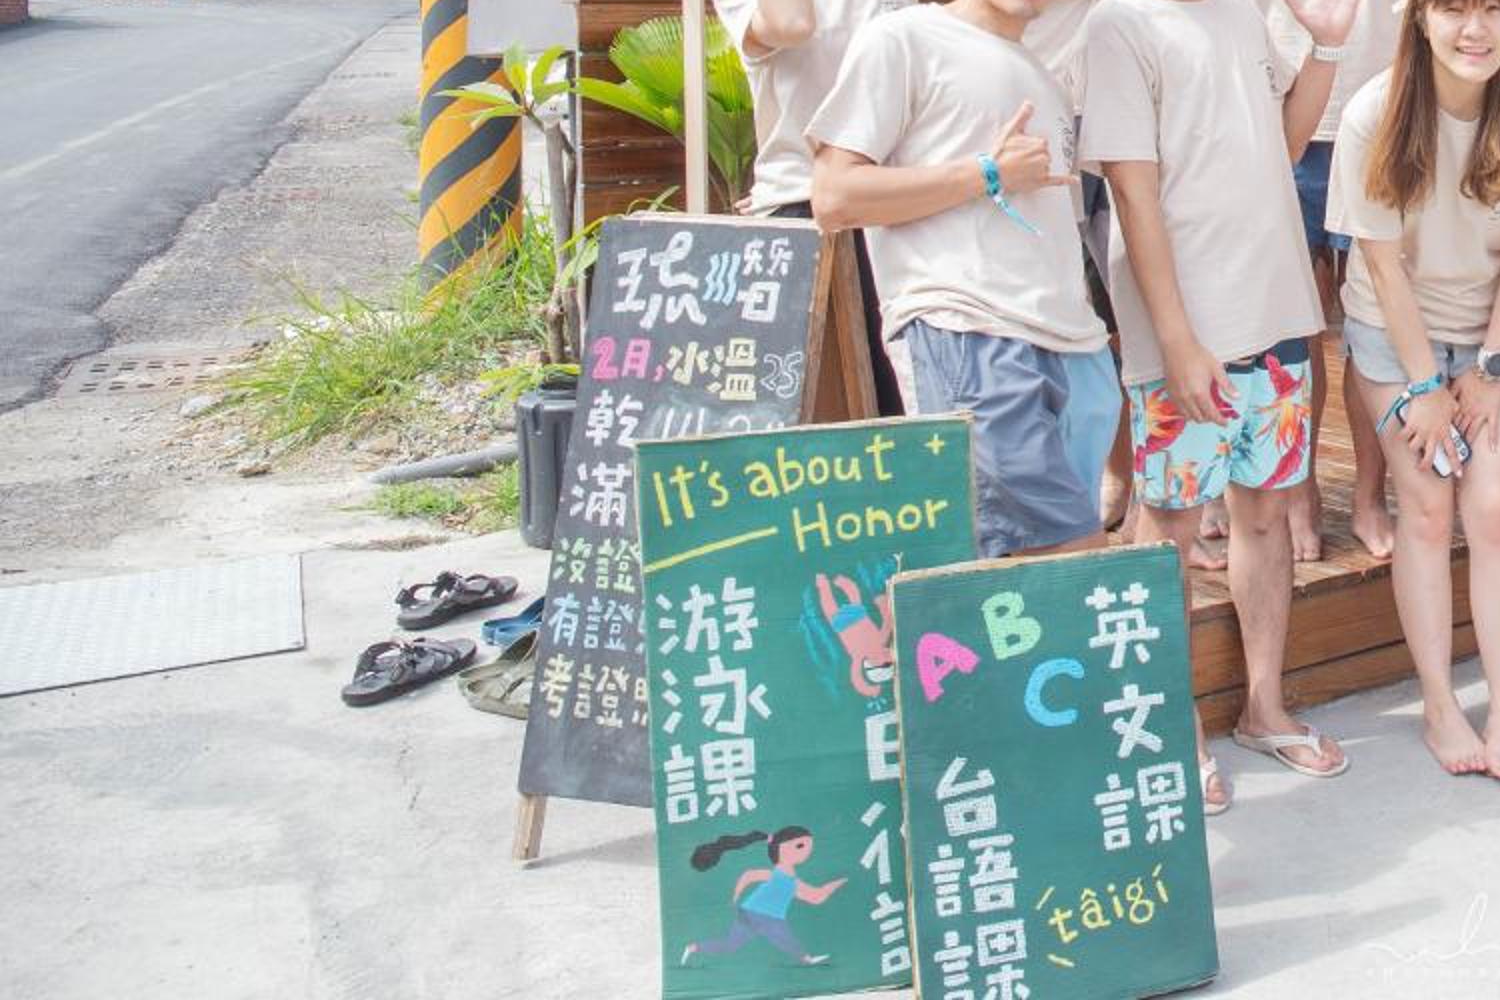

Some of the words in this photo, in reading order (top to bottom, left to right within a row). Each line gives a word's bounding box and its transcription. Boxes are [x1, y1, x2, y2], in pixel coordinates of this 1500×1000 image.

[651, 460, 731, 528] It's
[741, 434, 897, 501] about
[792, 498, 949, 553] Honor
[548, 593, 645, 652] 有證
[655, 576, 772, 825] 游泳課
[1085, 581, 1188, 852] 英文課
[928, 756, 1032, 1000] 台語課
